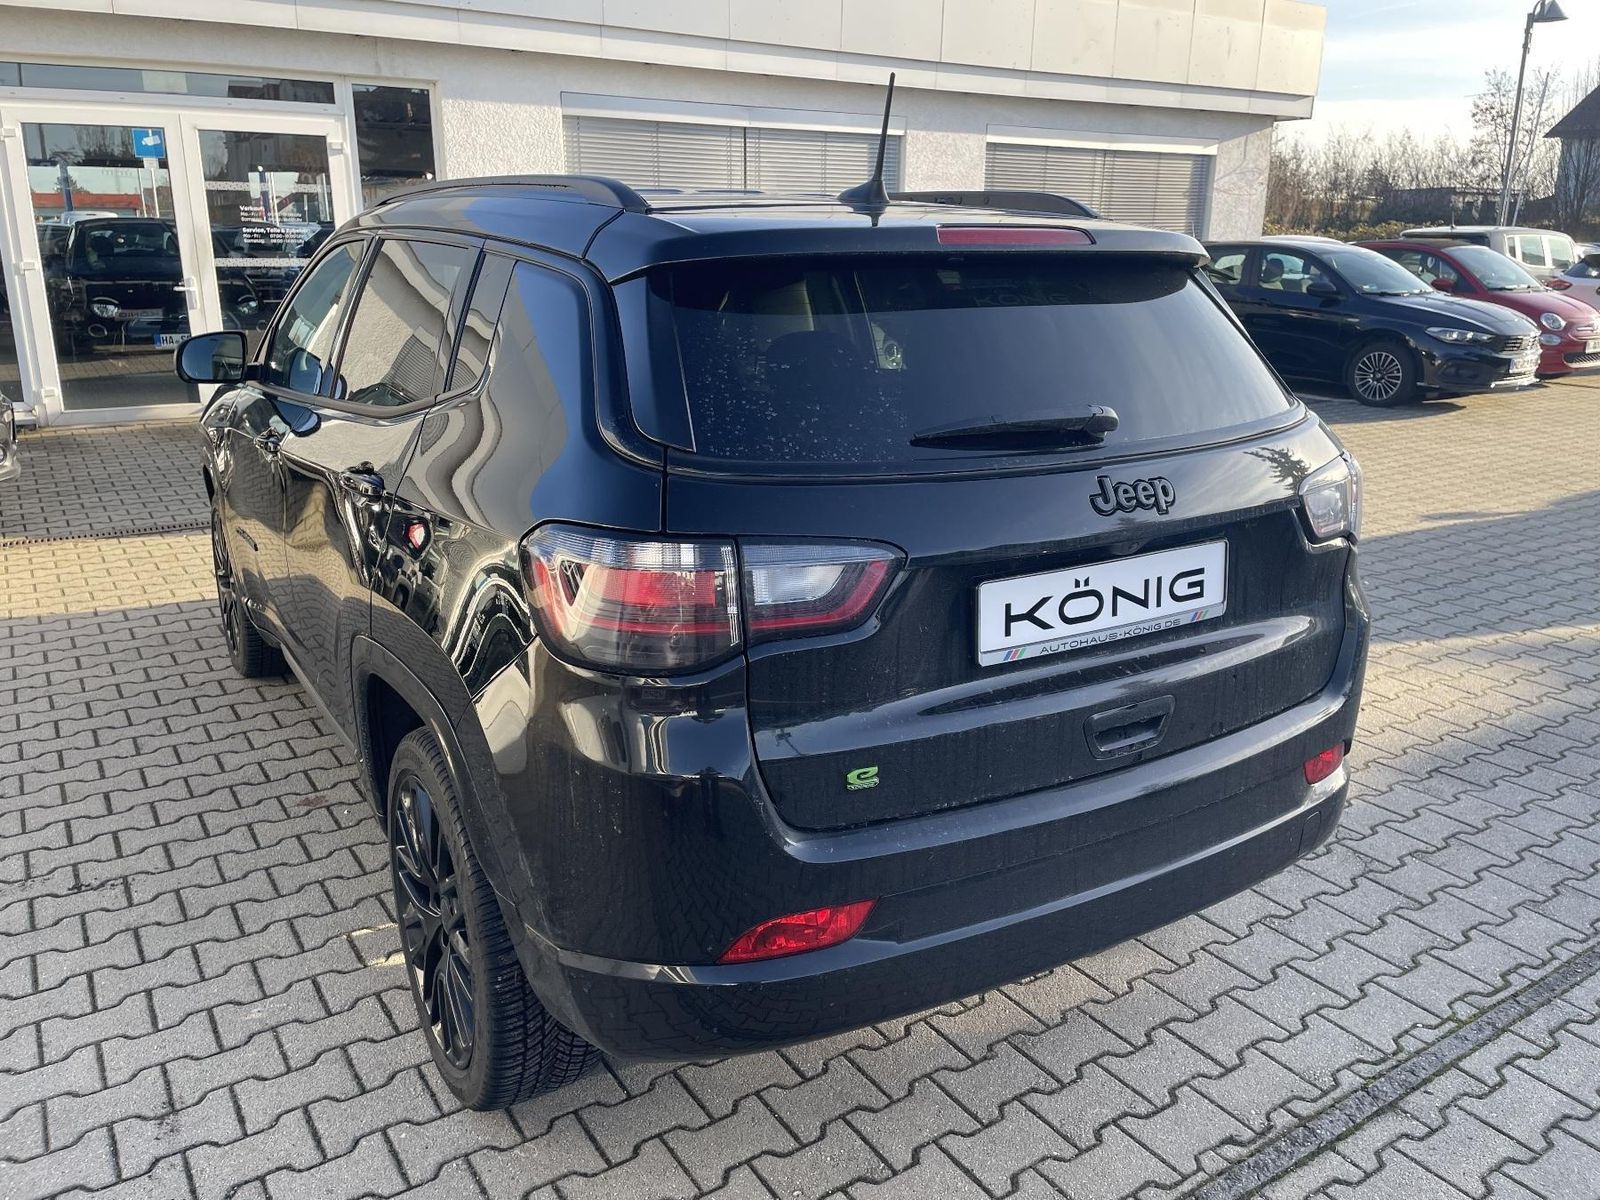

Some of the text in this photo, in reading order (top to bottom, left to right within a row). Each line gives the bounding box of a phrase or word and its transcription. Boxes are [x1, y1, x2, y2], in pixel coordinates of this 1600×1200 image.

[1088, 475, 1175, 516] Jeep
[1004, 567, 1205, 638] KÖNIG
[1039, 617, 1182, 655] AUTOHAUS-KÖNIG.DE
